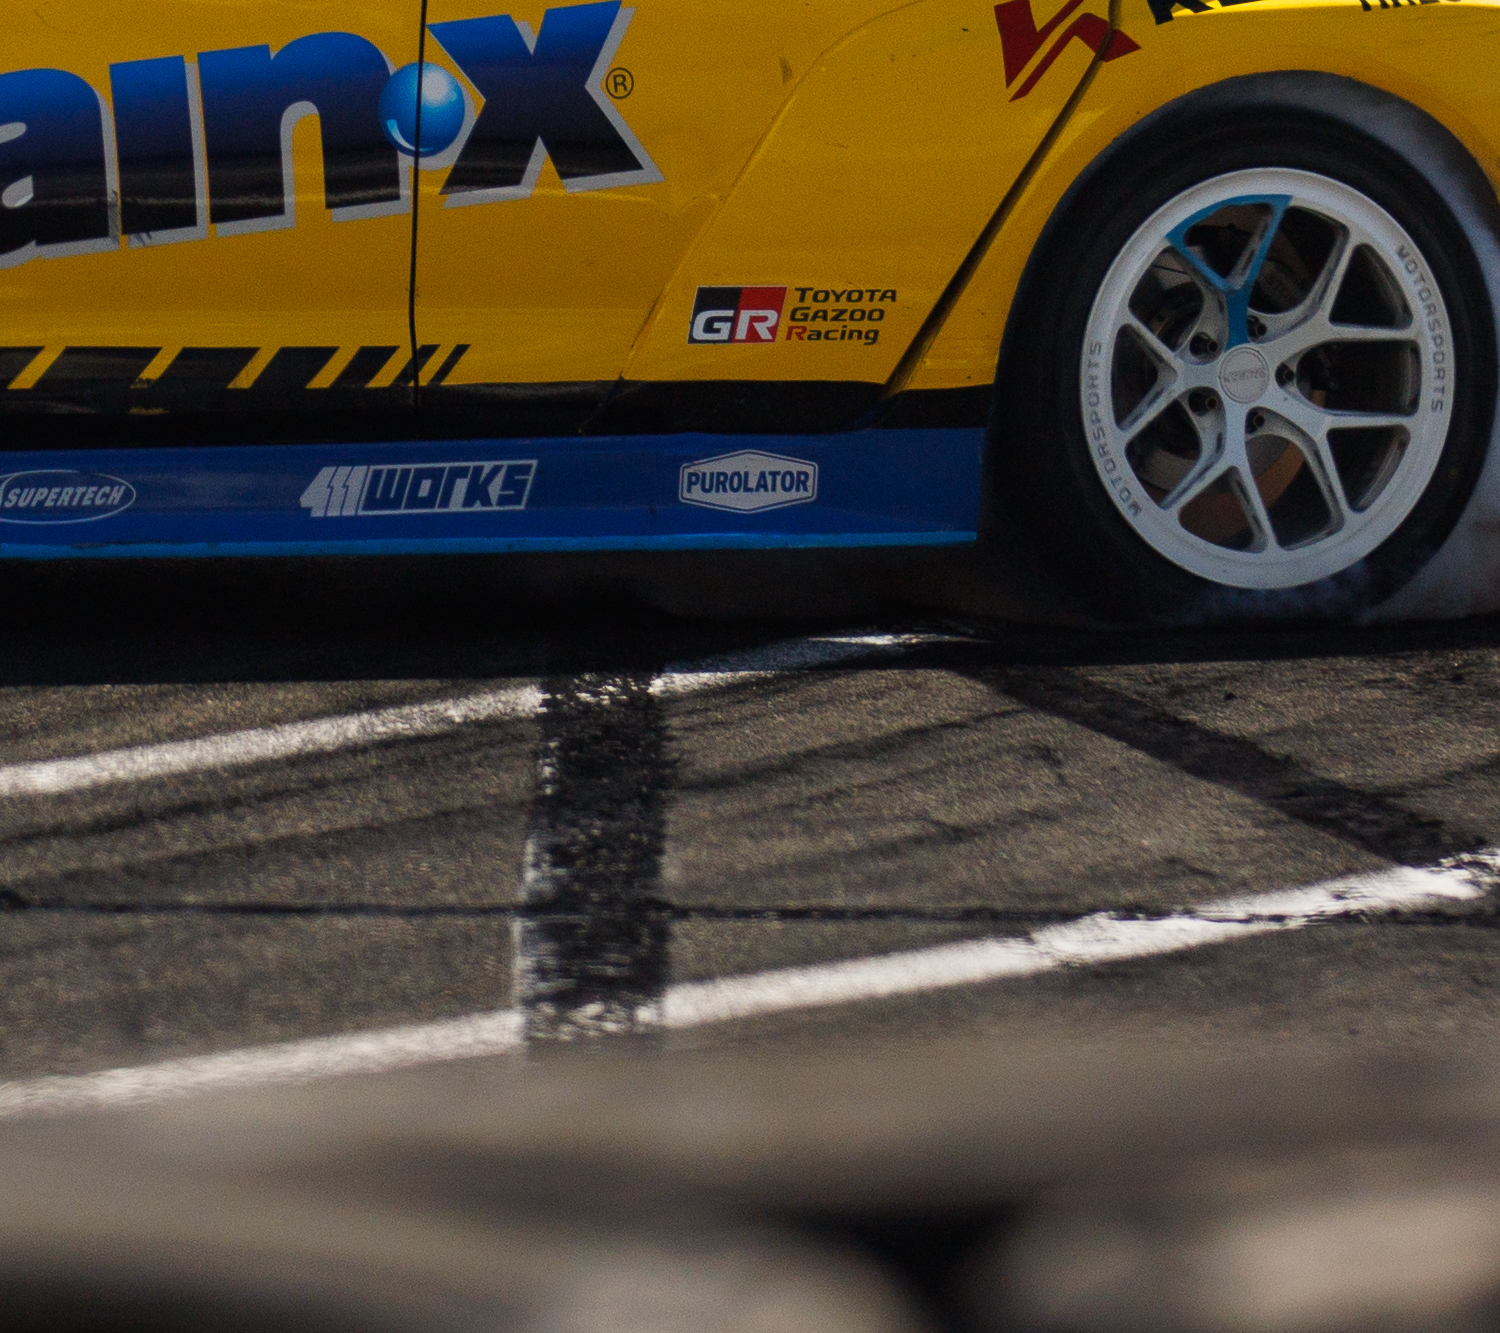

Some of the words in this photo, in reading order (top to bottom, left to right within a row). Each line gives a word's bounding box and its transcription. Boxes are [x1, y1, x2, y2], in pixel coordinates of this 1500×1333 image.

[794, 287, 898, 303] TOYOTA
[691, 308, 779, 341] GR
[789, 306, 886, 323] GAZOO
[785, 325, 881, 346] Racing
[685, 469, 810, 497] PUROLATOR
[3, 485, 126, 508] SUPERTECH
